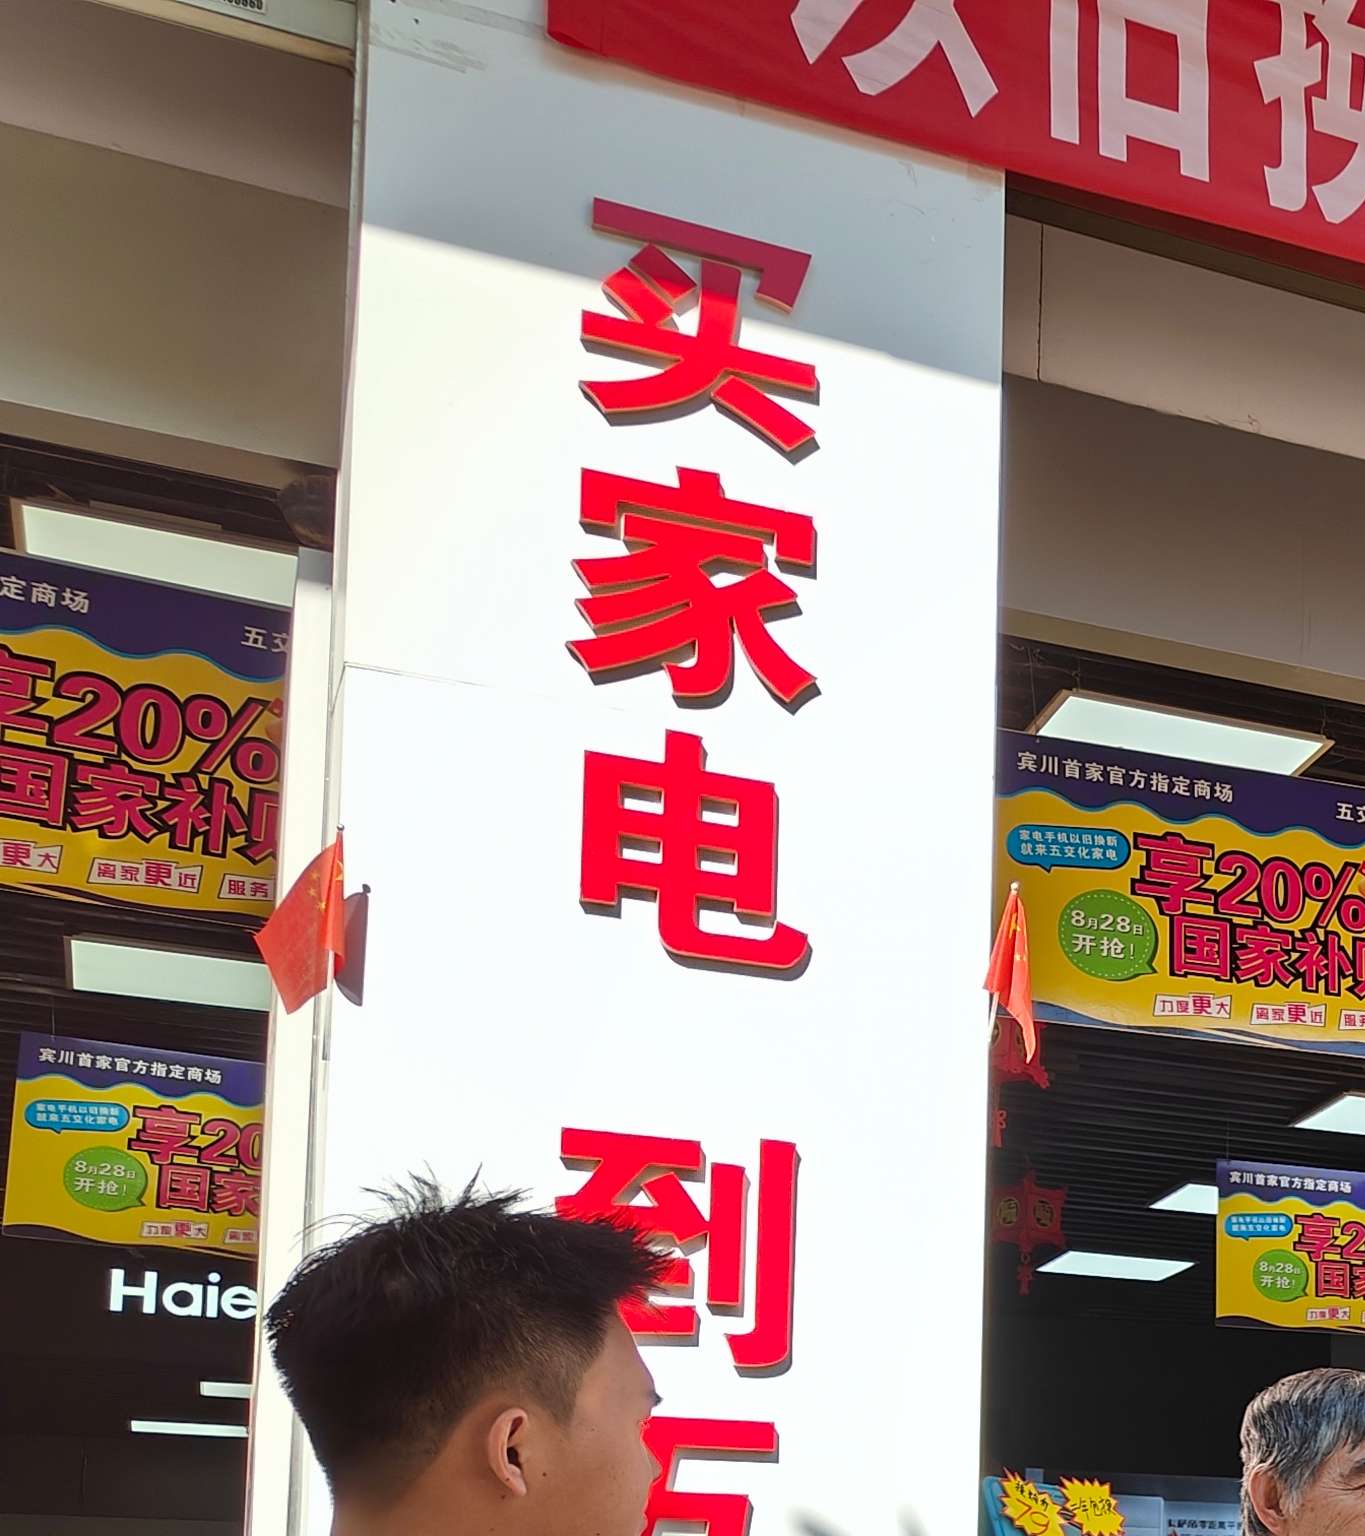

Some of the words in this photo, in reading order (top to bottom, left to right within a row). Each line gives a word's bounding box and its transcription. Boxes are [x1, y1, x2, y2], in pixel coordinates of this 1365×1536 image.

[566, 197, 822, 981] 买家电
[1016, 751, 1234, 804] 宾川首家官方指定商场
[1071, 909, 1144, 936] 8月28日
[38, 1046, 222, 1085] 宾川首家官方指定商场
[74, 1158, 137, 1180] 8月28日
[1229, 1170, 1351, 1194] 宾川首家官方指定商场
